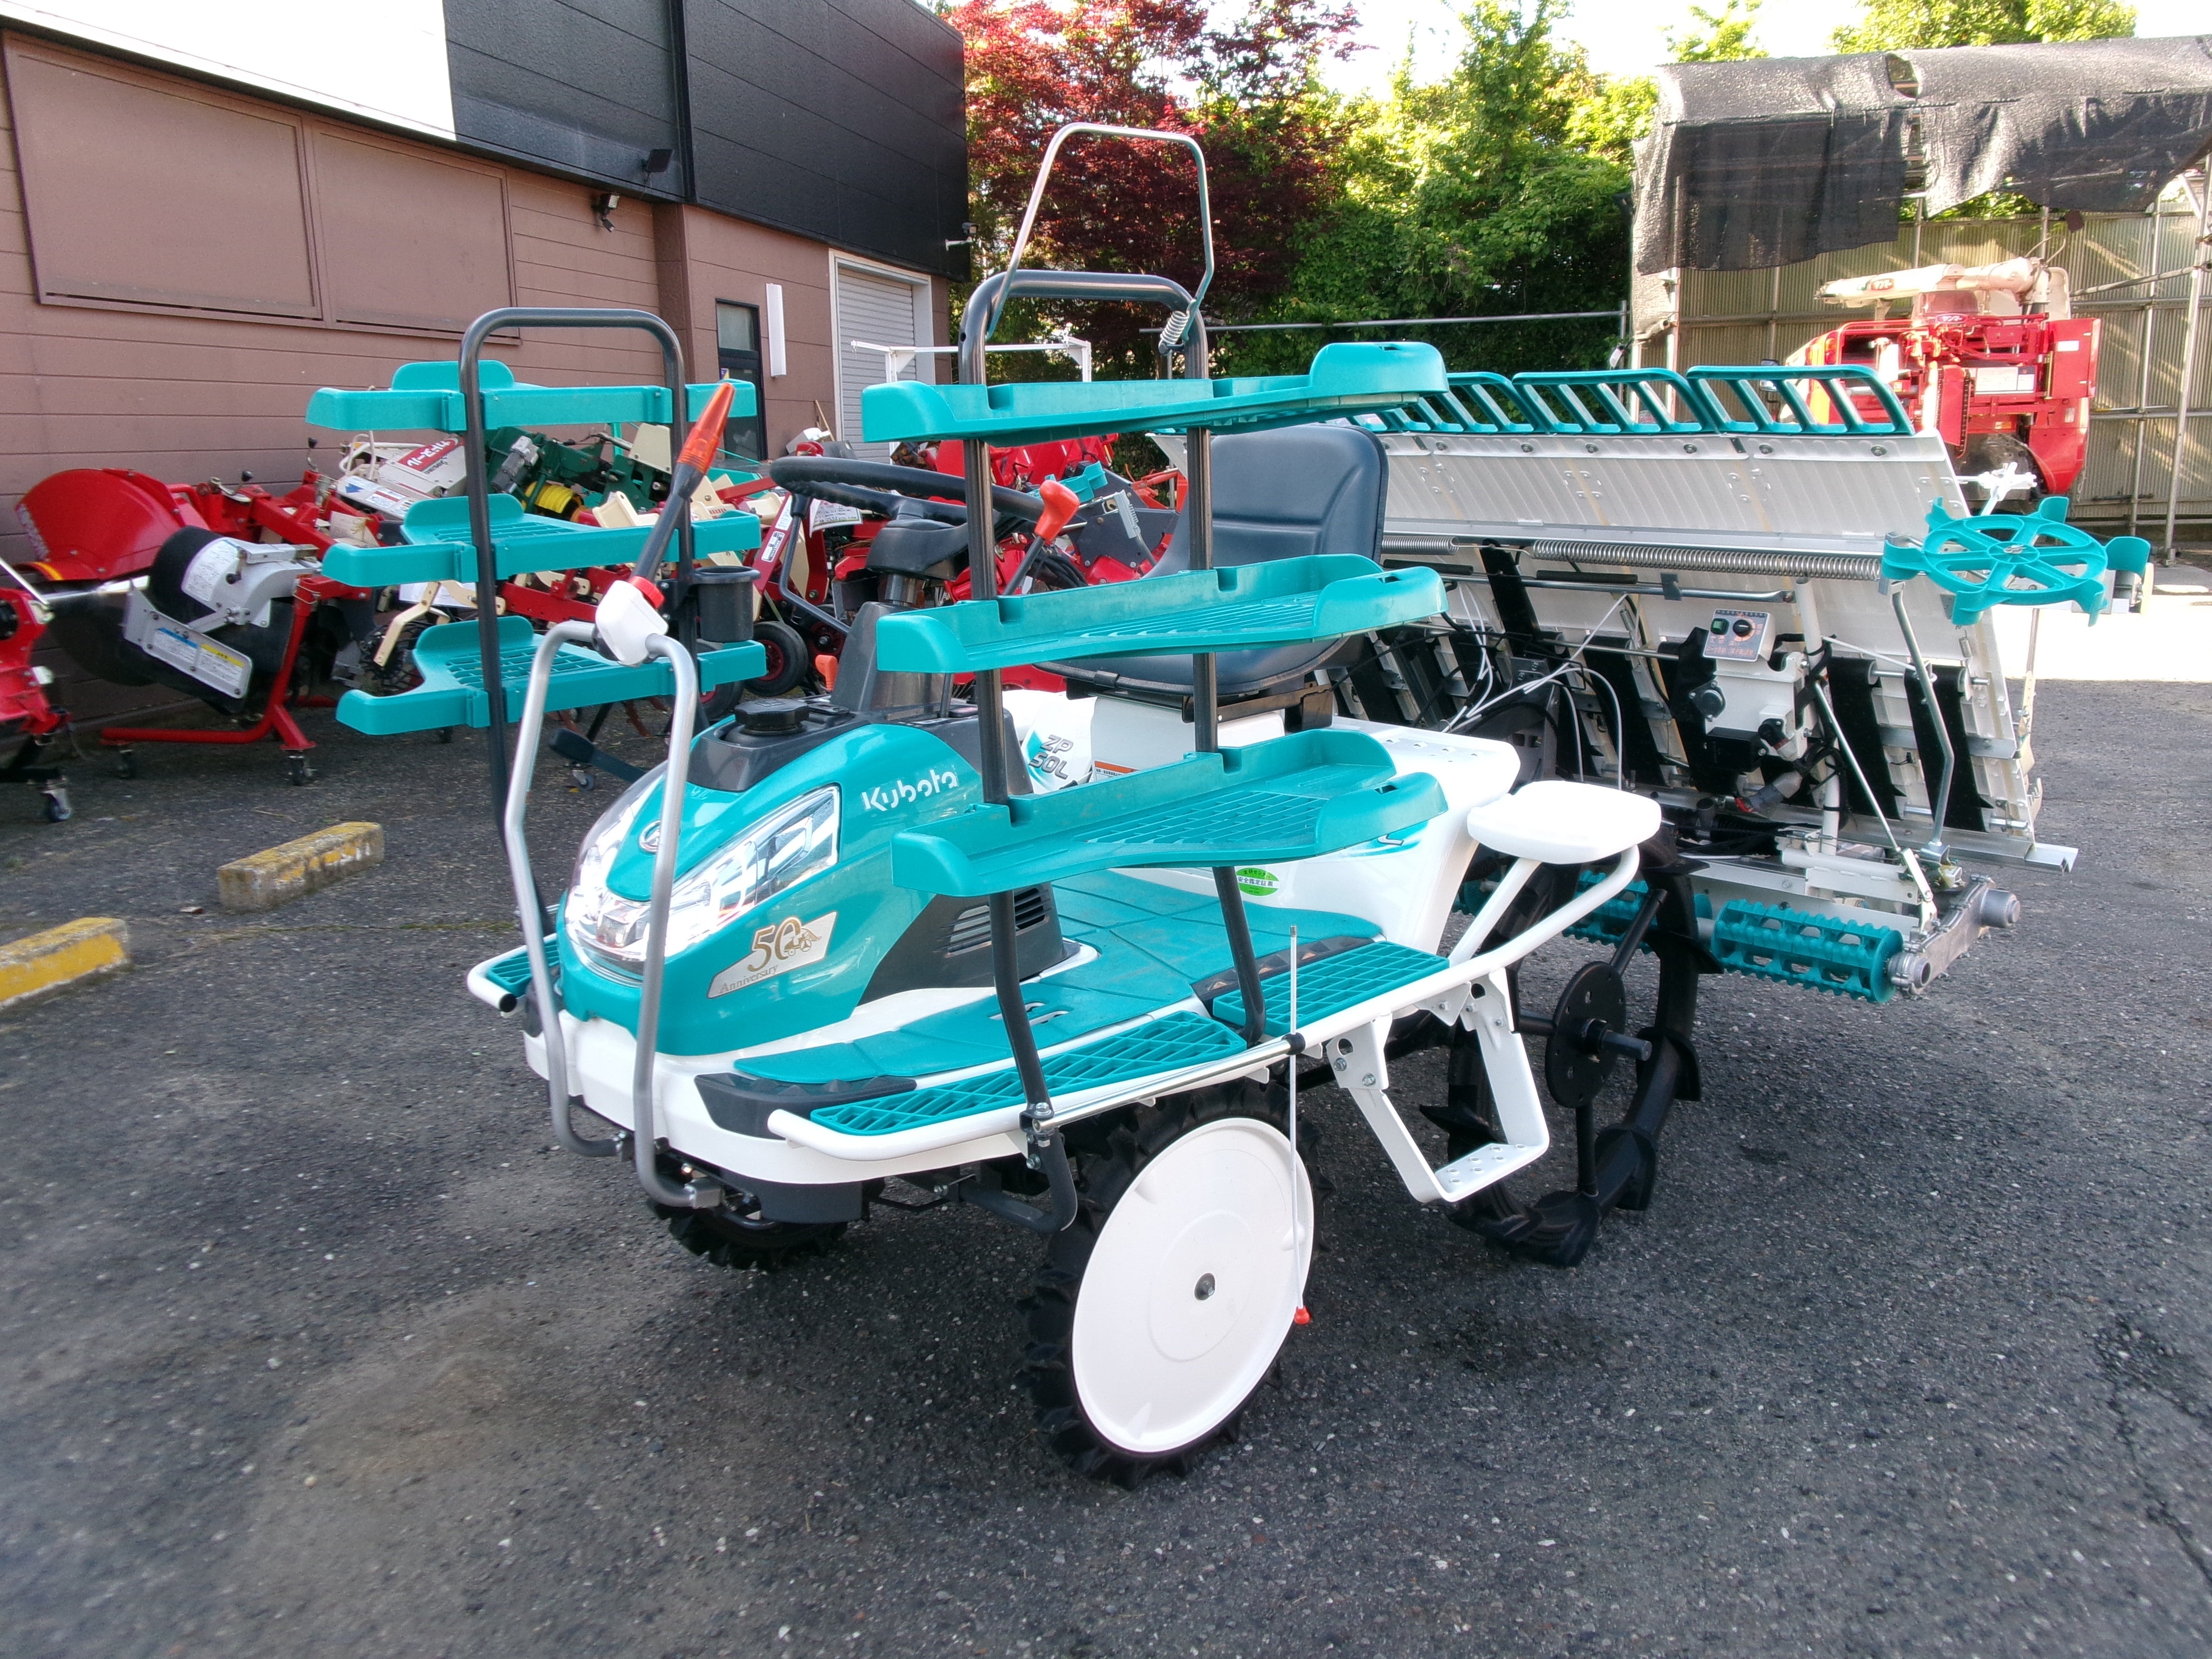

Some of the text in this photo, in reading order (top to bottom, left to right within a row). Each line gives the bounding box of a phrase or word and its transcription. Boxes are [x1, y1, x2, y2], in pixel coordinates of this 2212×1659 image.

[1040, 734, 1073, 753] ZP
[862, 769, 958, 811] Kubota
[747, 917, 802, 972] 50
[720, 965, 778, 994] Anniversary
